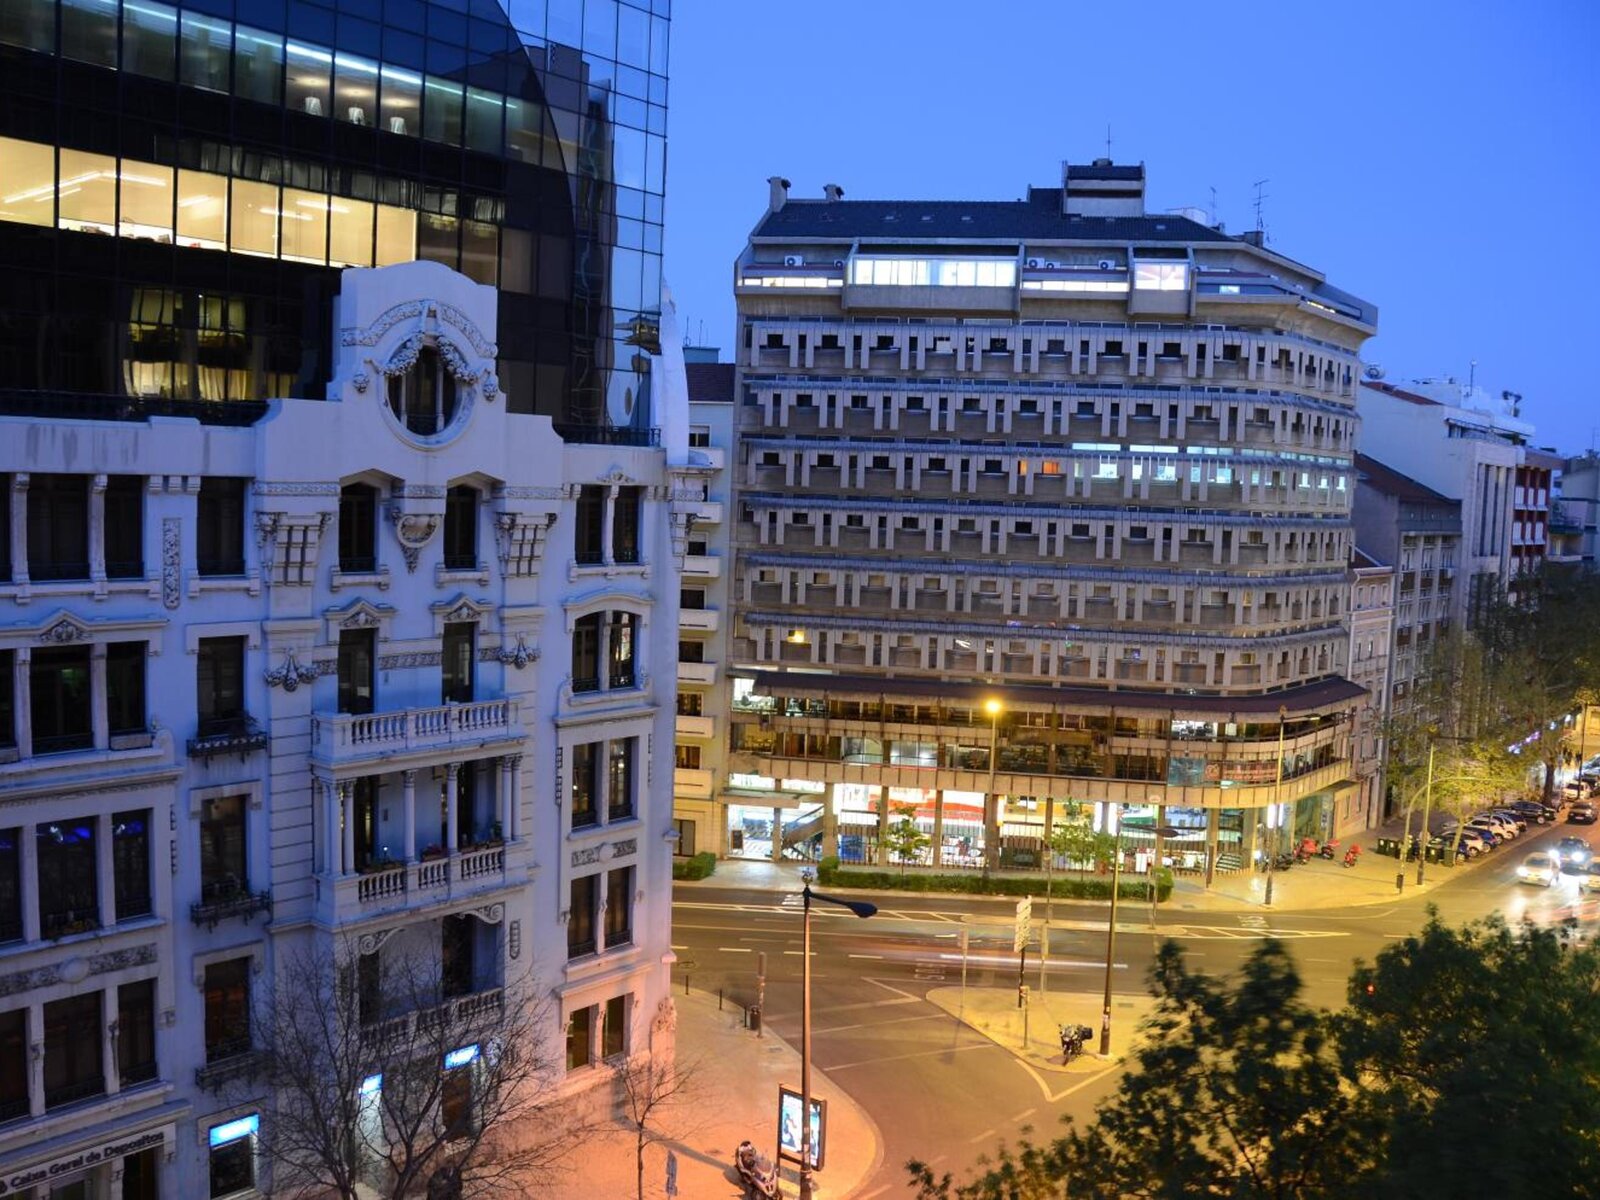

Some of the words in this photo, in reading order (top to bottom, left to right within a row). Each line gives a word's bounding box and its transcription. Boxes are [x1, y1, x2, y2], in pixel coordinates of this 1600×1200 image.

[10, 1170, 47, 1188] Caixa
[49, 1155, 83, 1175] Geral
[86, 1151, 102, 1164] de
